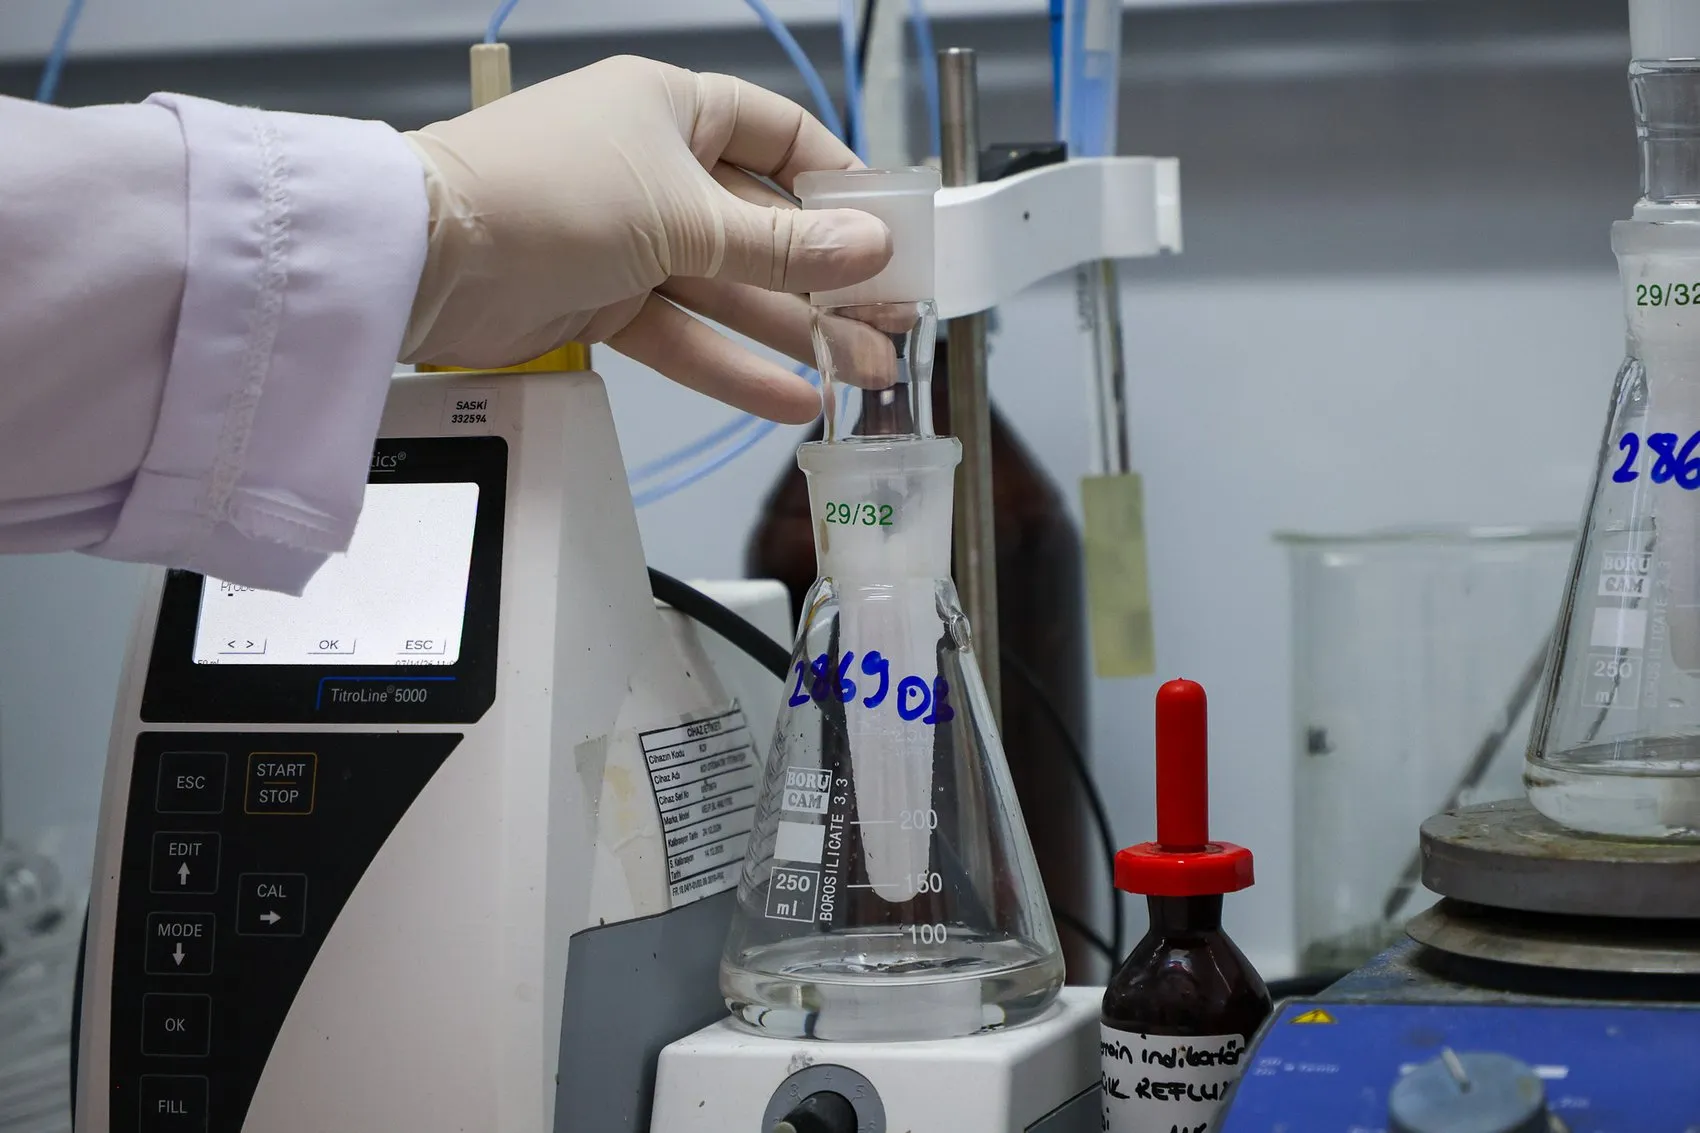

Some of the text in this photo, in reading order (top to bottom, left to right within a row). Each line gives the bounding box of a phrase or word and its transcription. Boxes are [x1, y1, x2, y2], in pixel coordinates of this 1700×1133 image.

[1636, 283, 1700, 306] 29/32
[456, 400, 487, 410] SASKİ
[451, 414, 486, 424] 332594
[825, 502, 894, 526] 29/32
[1603, 555, 1651, 575] BORU
[1605, 577, 1645, 593] CAM
[319, 640, 339, 650] OK
[405, 639, 433, 650] ESC
[1594, 660, 1632, 679] 250
[788, 650, 890, 709] 2869
[395, 688, 428, 703] 5000
[256, 764, 306, 777] START
[176, 776, 206, 790] ESC
[653, 775, 671, 784] Cihaz
[787, 771, 830, 791] BORU
[259, 790, 299, 803] STOP
[787, 792, 823, 809] CAM
[900, 809, 938, 830] 200
[168, 842, 203, 856] EDIT
[819, 813, 845, 922] BOROSILICATE
[775, 873, 811, 892] 250
[904, 872, 942, 893] 150
[257, 884, 287, 898] CAL
[776, 900, 798, 916] ml
[157, 924, 203, 937] MODE
[908, 923, 947, 945] 100
[165, 1018, 186, 1031] OK
[158, 1100, 188, 1114] FILL
